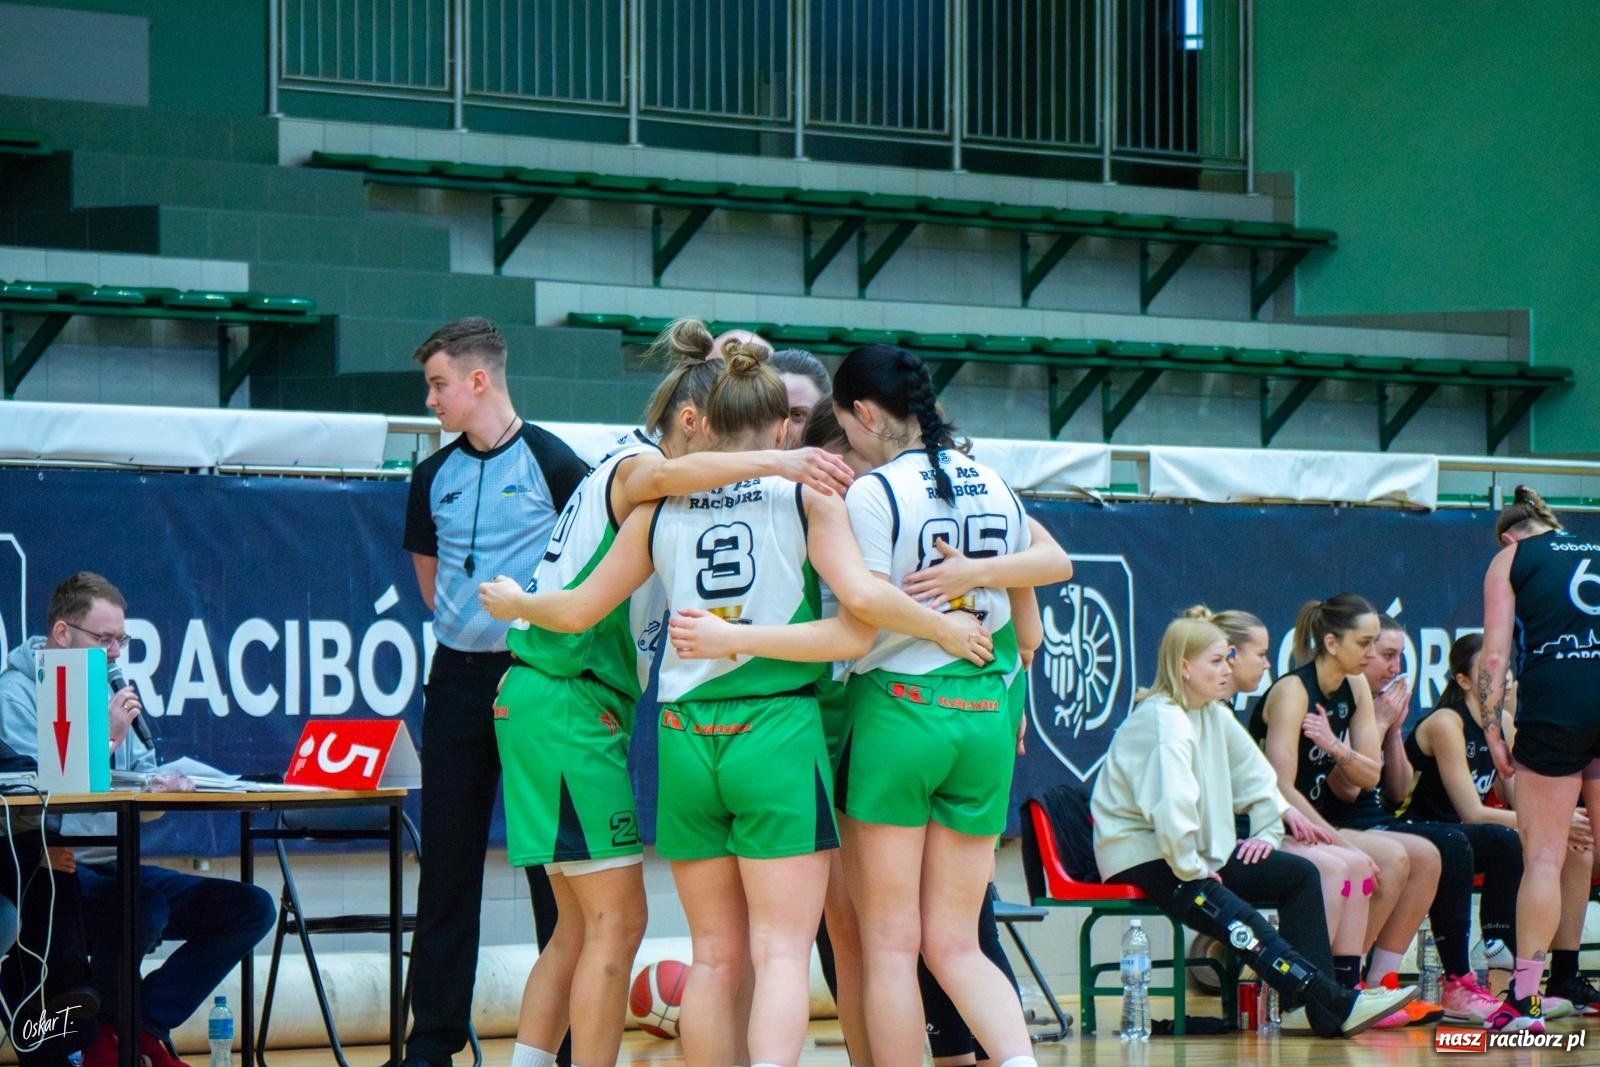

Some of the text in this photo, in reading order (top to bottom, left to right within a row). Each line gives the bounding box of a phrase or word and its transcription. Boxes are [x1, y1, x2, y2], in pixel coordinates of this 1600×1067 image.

[696, 521, 756, 600] 3
[124, 585, 433, 717] RACIBÓ
[318, 731, 381, 778] 5
